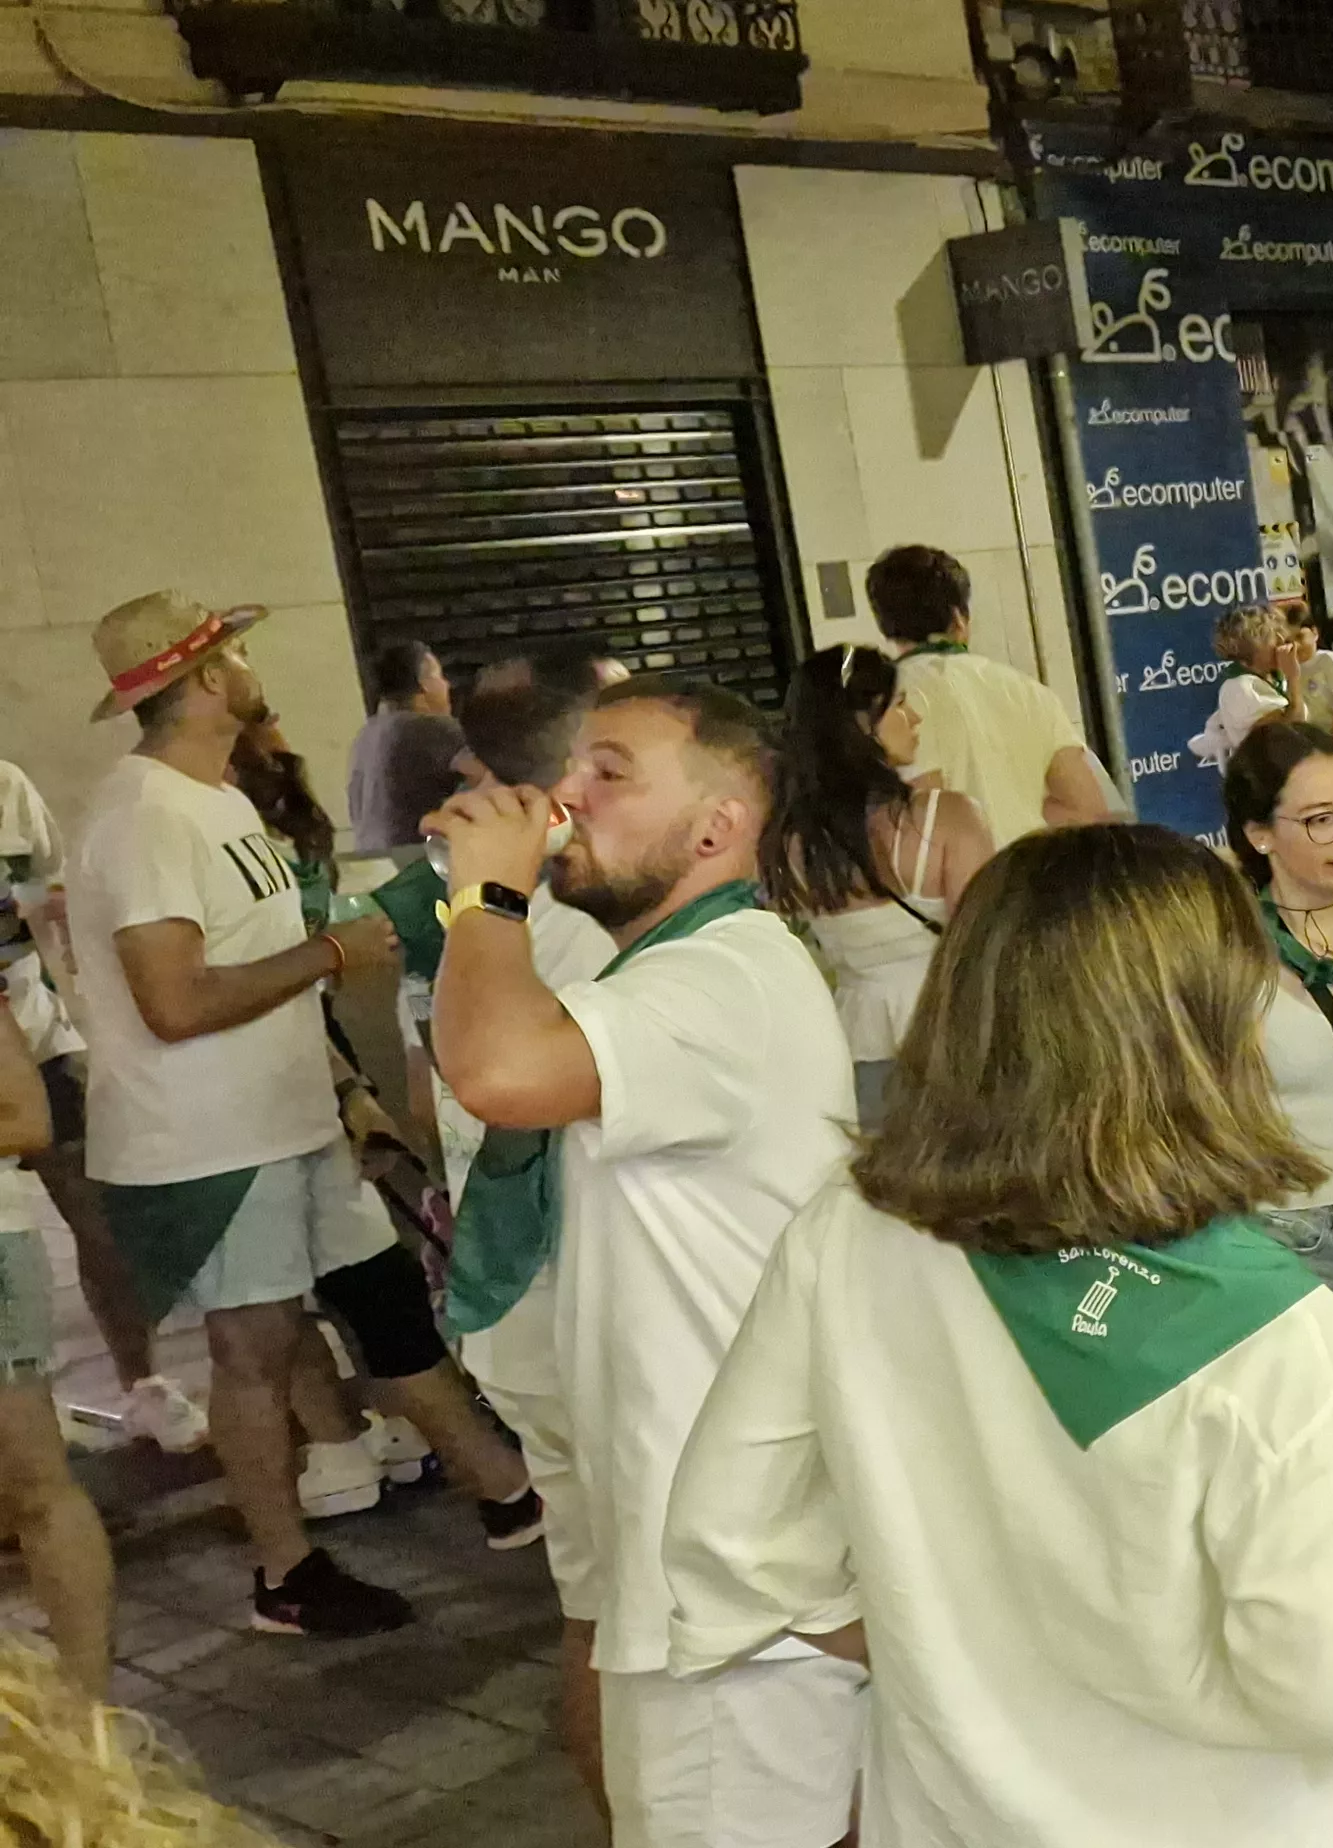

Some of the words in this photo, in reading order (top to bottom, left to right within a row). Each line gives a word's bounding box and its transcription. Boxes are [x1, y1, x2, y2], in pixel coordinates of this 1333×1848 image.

[365, 198, 667, 258] MANGO
[498, 266, 561, 283] MAN
[1123, 476, 1245, 509] ecomputer
[1094, 1247, 1161, 1285] Lorenzo
[1072, 1313, 1108, 1337] Paula
